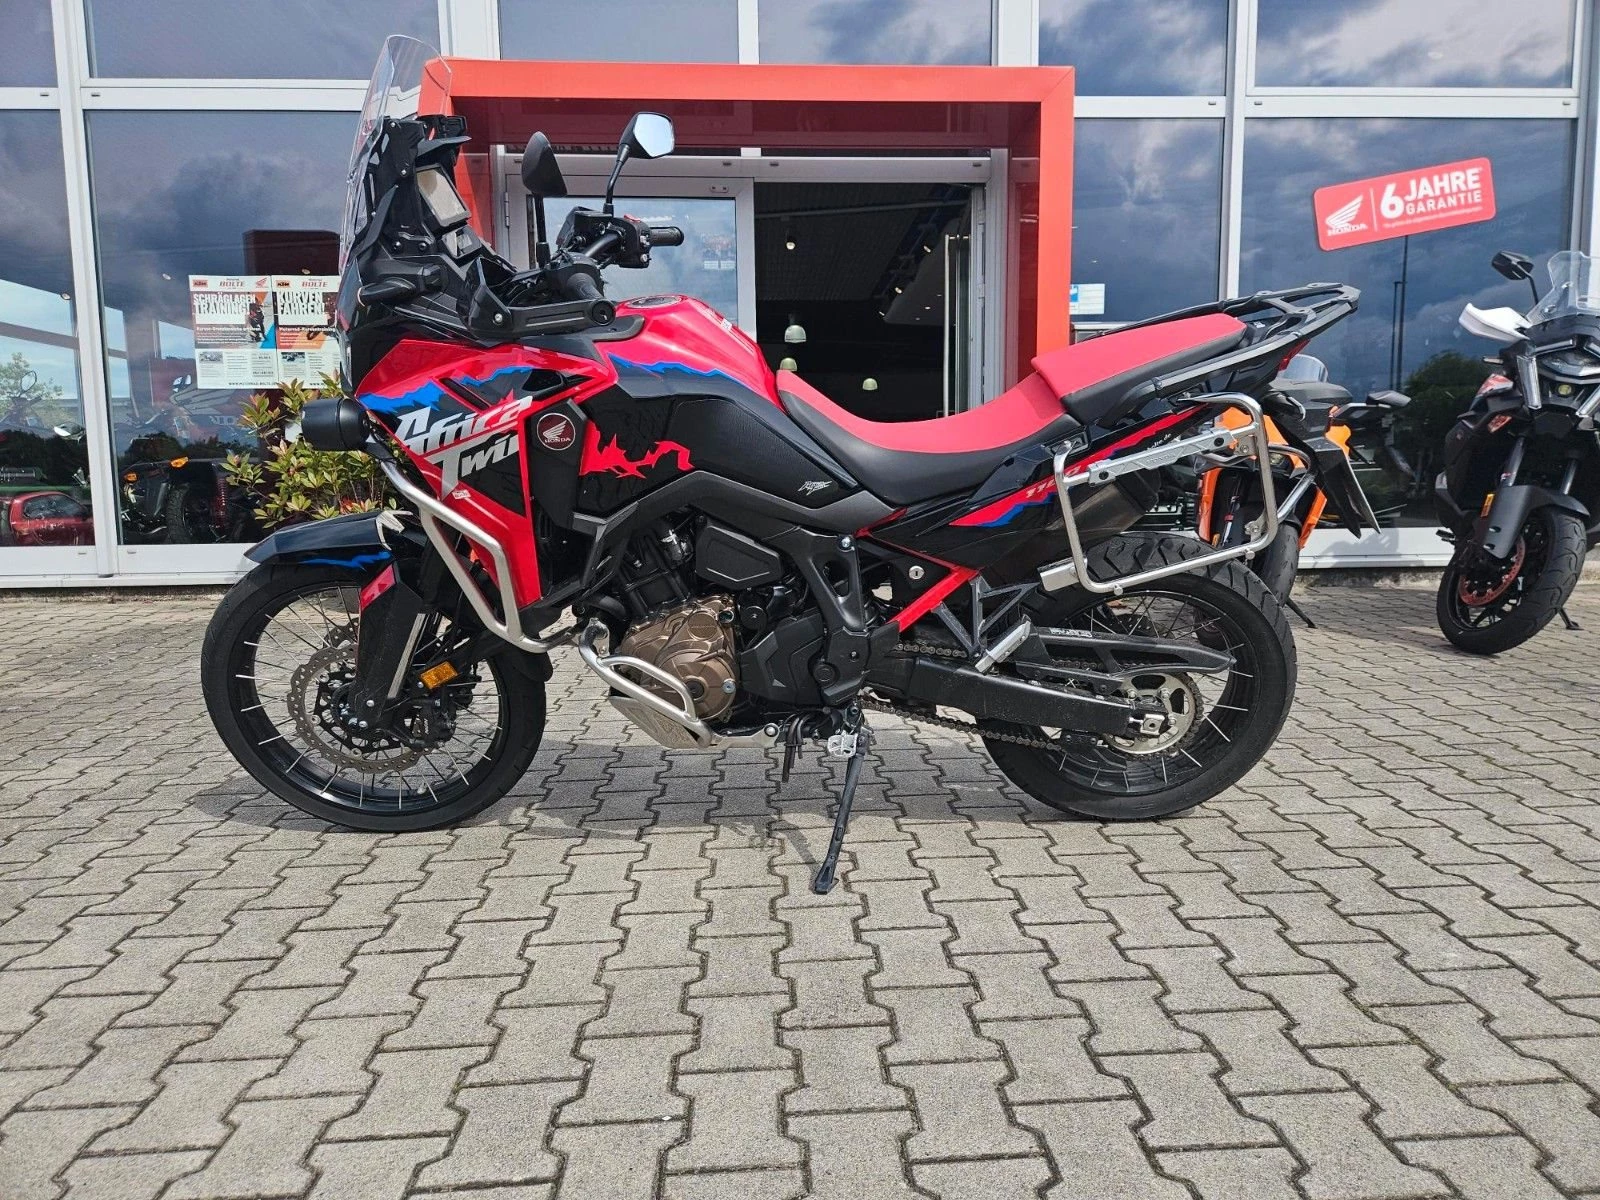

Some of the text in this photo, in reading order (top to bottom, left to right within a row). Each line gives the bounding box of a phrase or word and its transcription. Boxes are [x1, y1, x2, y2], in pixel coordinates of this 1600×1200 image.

[1380, 182, 1405, 219] 6
[1405, 190, 1482, 215] GARANTIE
[1327, 223, 1368, 236] HONDA
[278, 291, 323, 303] KURVEN
[394, 396, 533, 455] Africa
